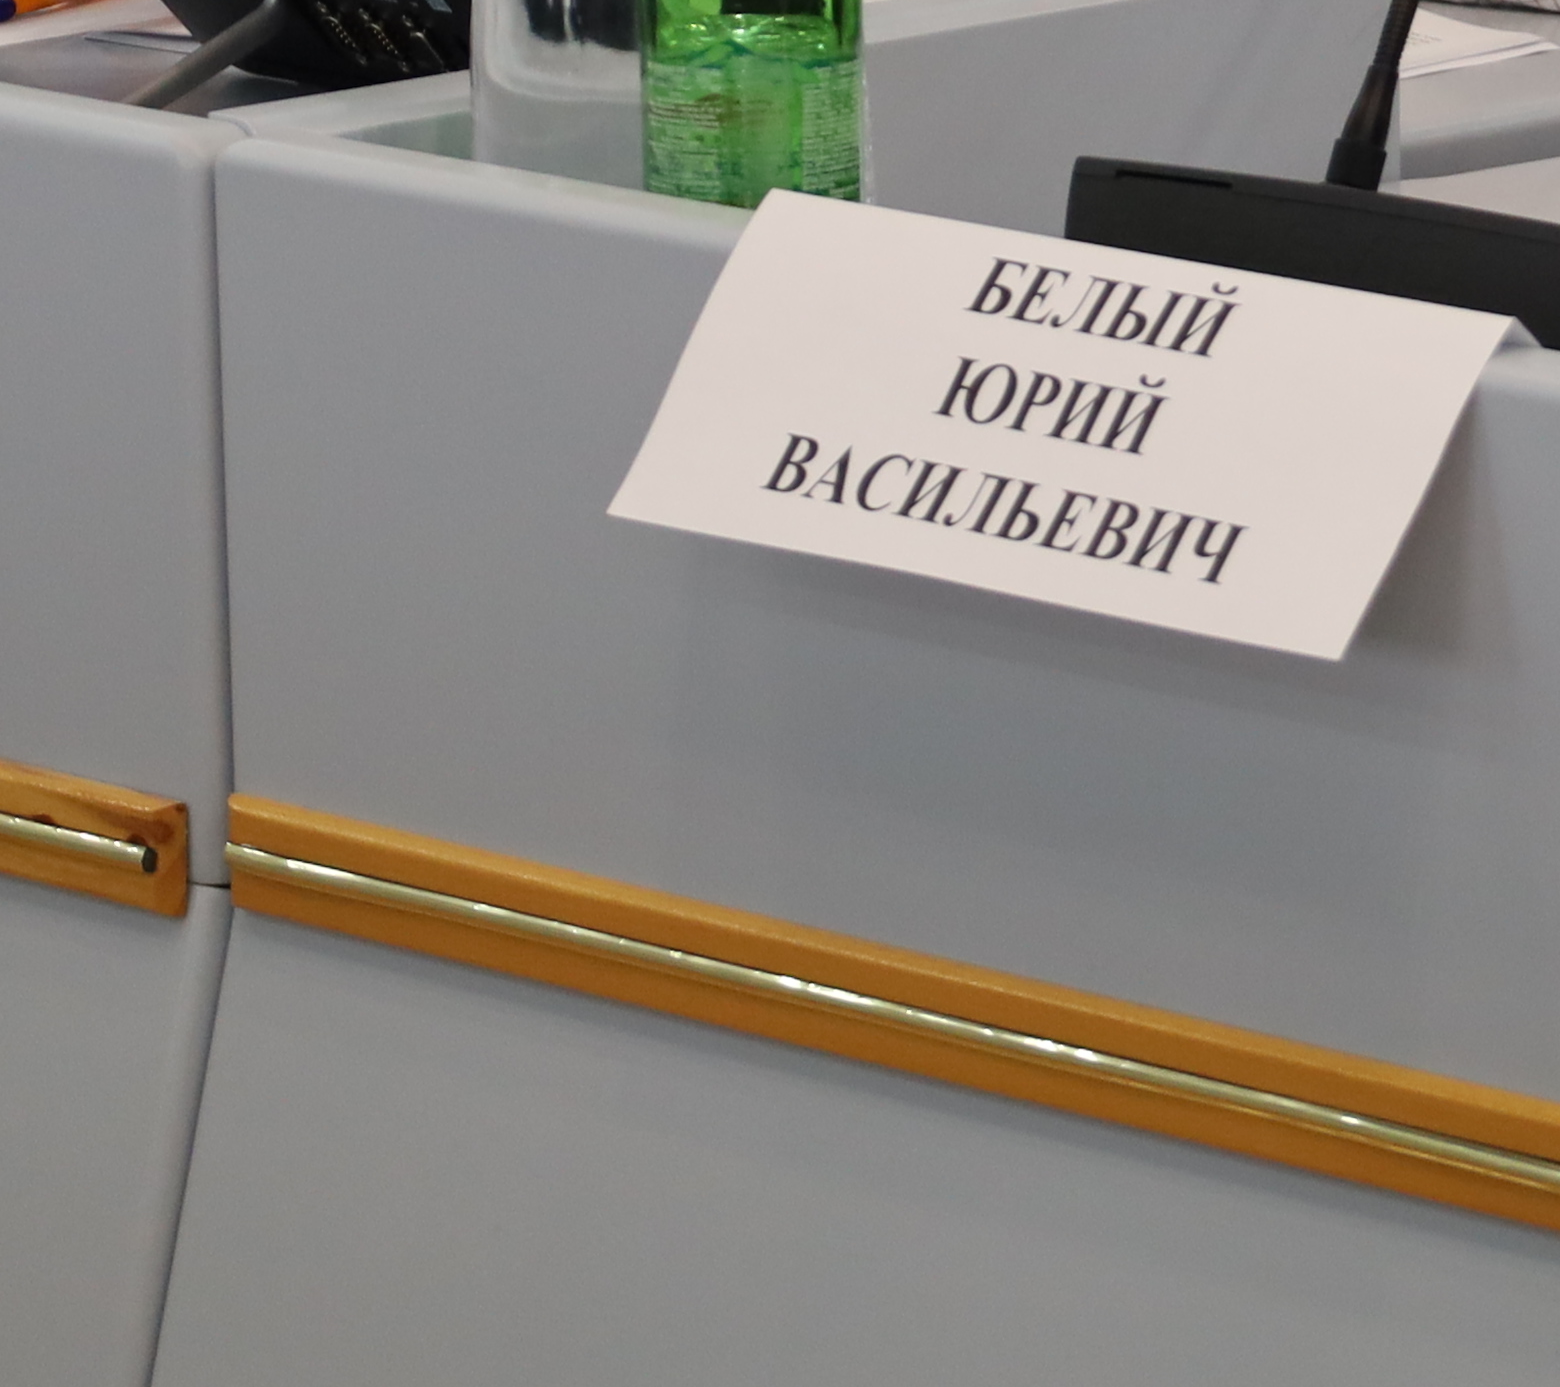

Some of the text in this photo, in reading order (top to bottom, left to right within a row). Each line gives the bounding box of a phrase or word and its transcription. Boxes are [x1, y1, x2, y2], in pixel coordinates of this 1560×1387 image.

[963, 256, 1241, 358] БЕЛЫЙ
[932, 356, 1169, 455] ЮРИЙ
[761, 433, 1246, 585] ВАСИЛЬЕВИЧ
